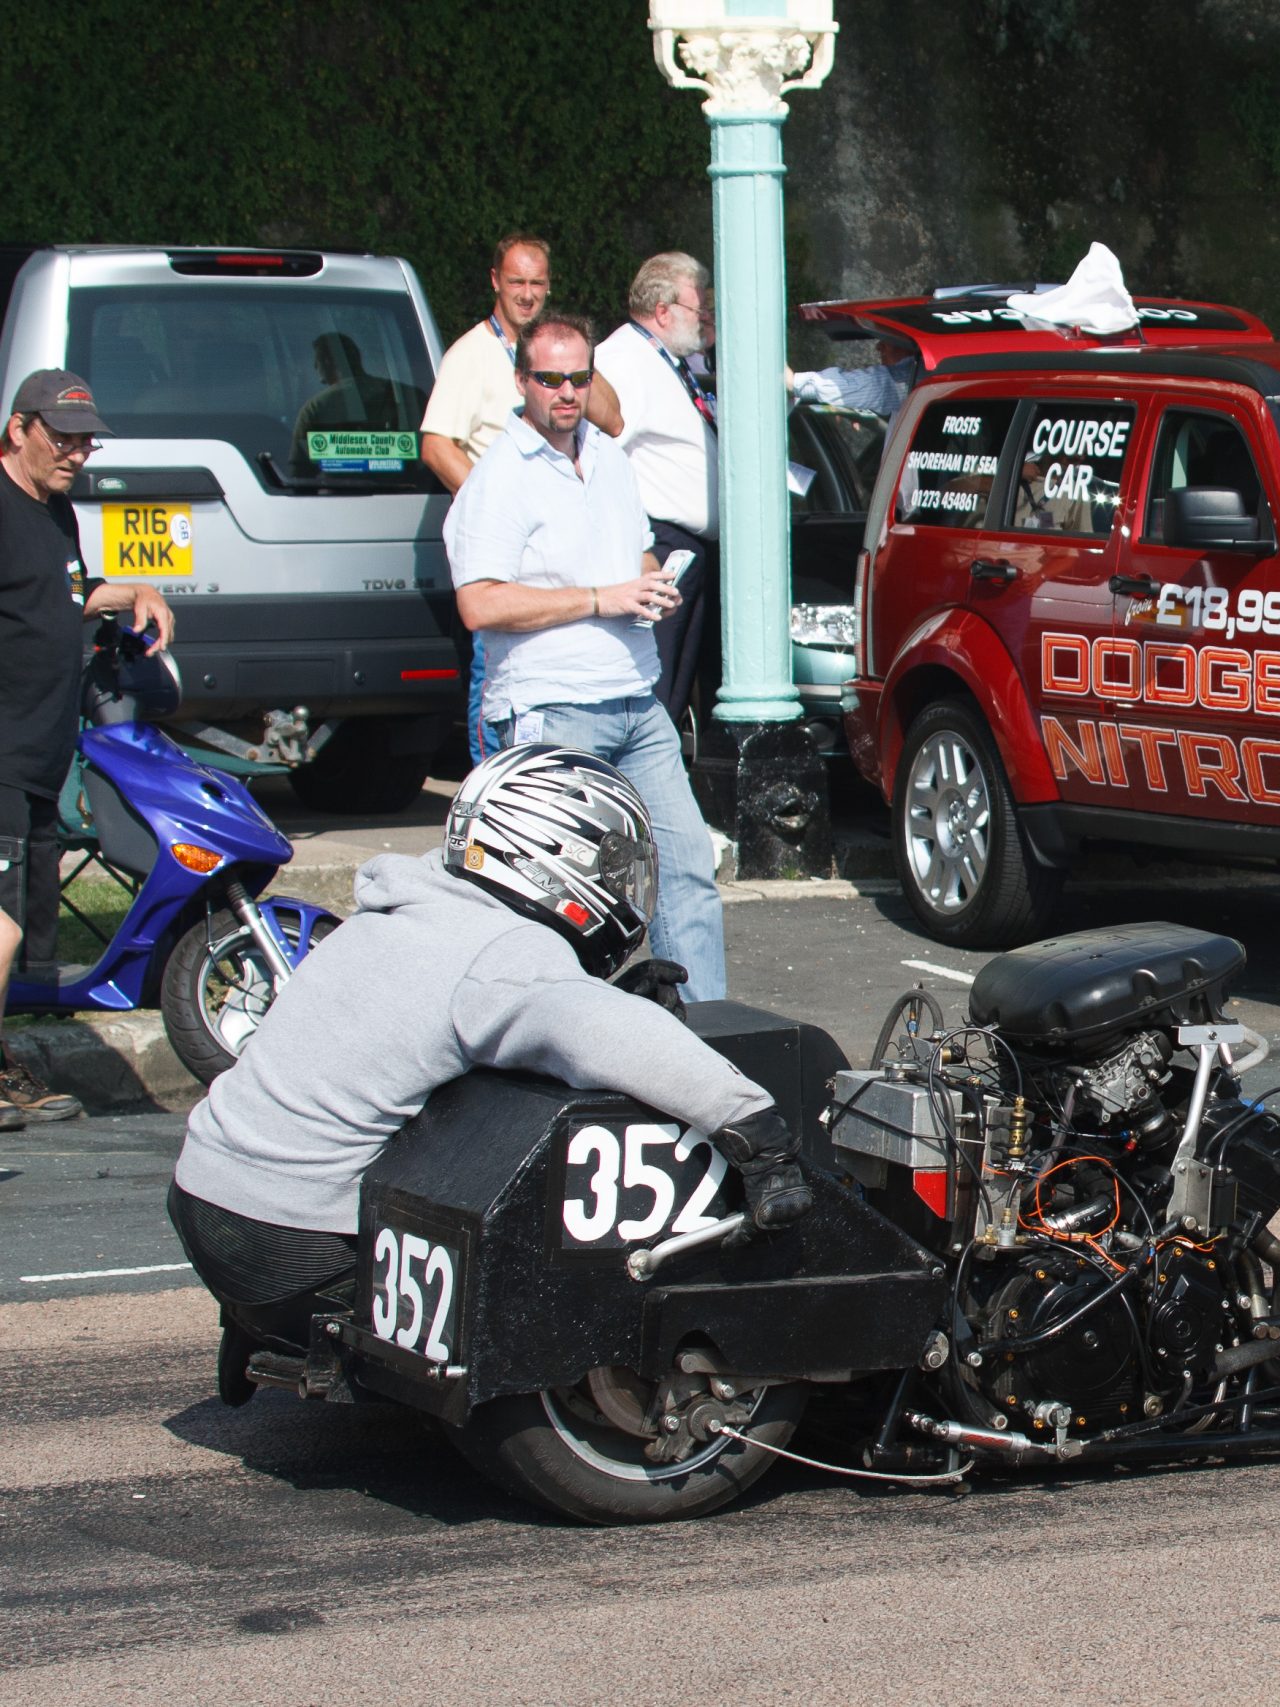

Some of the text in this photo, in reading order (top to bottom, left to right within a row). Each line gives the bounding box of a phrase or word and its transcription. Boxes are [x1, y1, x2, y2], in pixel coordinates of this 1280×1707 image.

[942, 416, 981, 435] FROSTS
[1033, 419, 1130, 457] COURSE
[329, 433, 396, 447] Middlesex County
[335, 446, 390, 456] Automobile Club
[908, 451, 998, 474] SHOREHAM BY SEA
[1044, 463, 1093, 501] CAR
[911, 489, 978, 511] 01273 454861
[124, 508, 167, 535] R16
[180, 520, 189, 540] GB
[119, 541, 174, 568] KNK
[362, 579, 406, 590] TDV6
[1124, 598, 1152, 627] from
[563, 1124, 728, 1242] 352
[373, 1228, 454, 1362] 352
